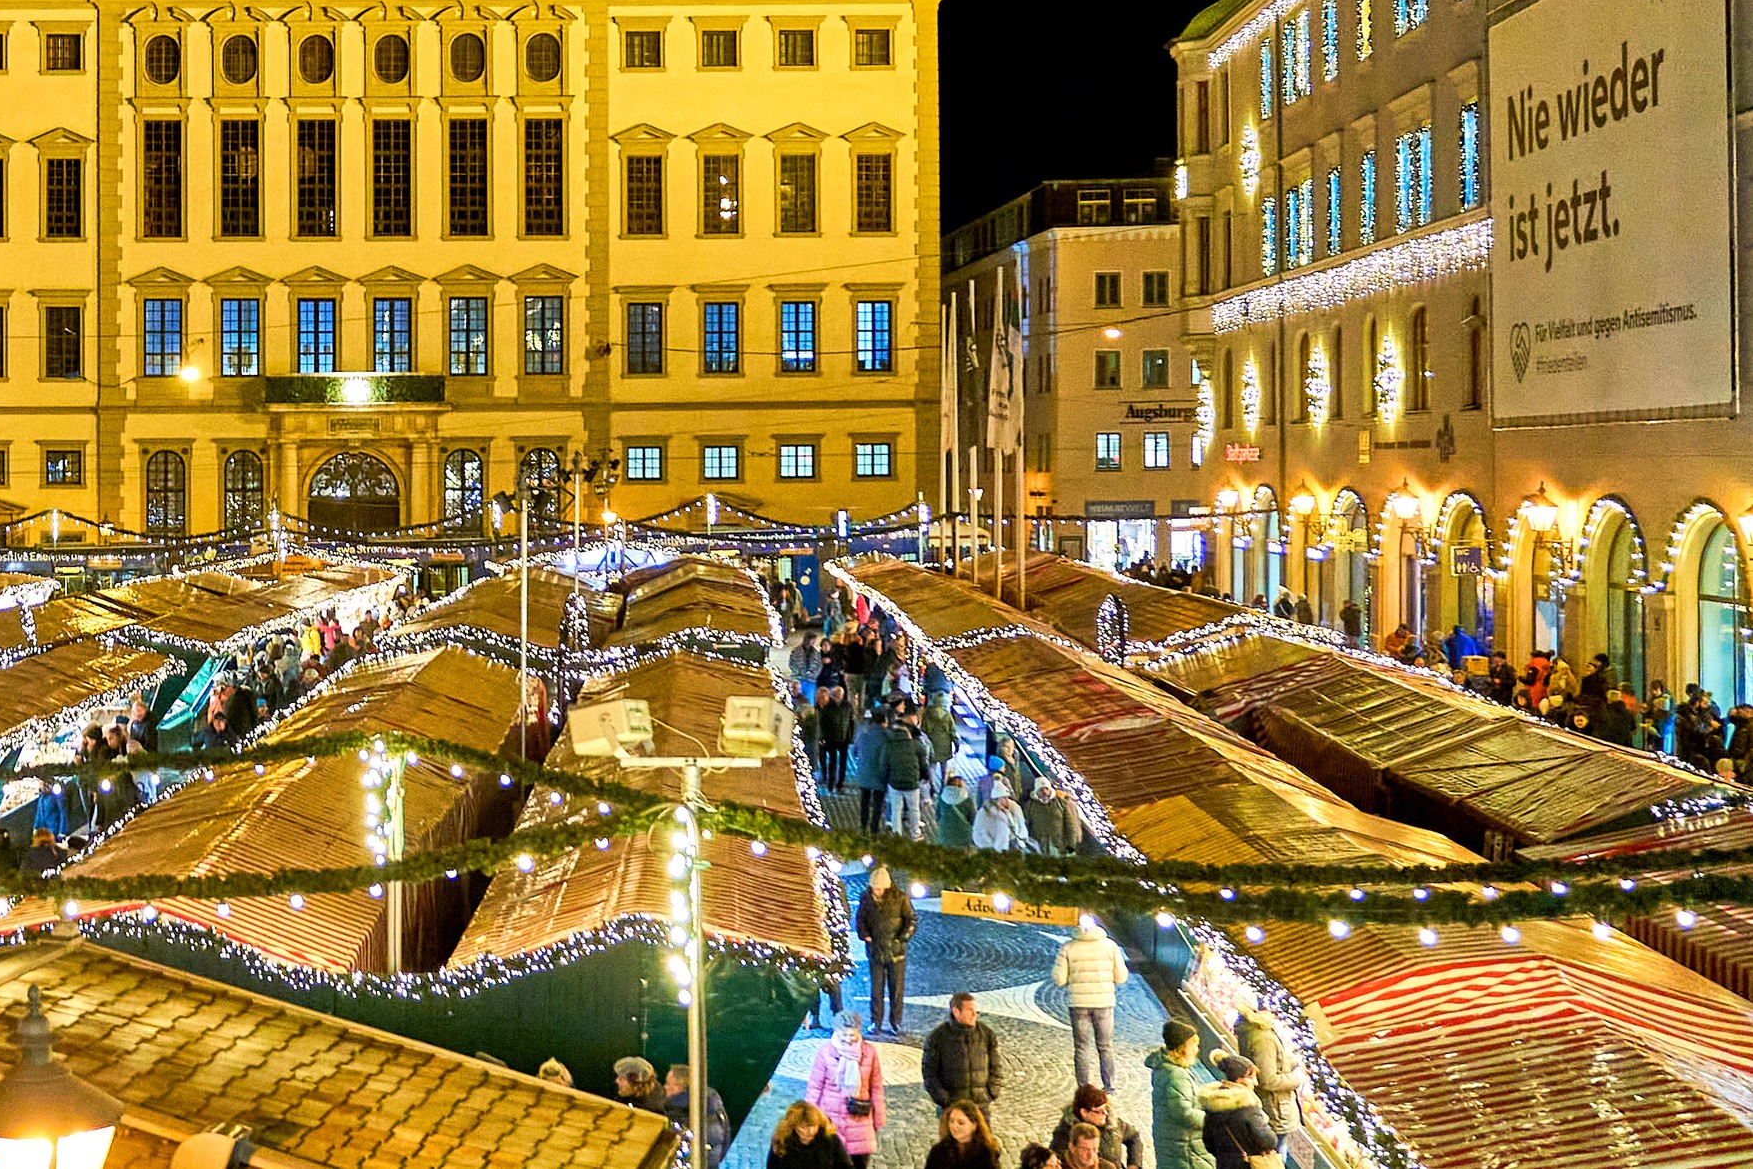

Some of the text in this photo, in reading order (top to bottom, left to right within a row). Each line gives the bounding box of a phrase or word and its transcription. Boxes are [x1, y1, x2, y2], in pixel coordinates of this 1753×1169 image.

[1507, 41, 1665, 161] Nie wieder
[1509, 169, 1620, 273] ist jetzt.
[1535, 303, 1698, 343] Für Vielfalt und gegen Antisemitismus.
[1455, 548, 1471, 557] WC
